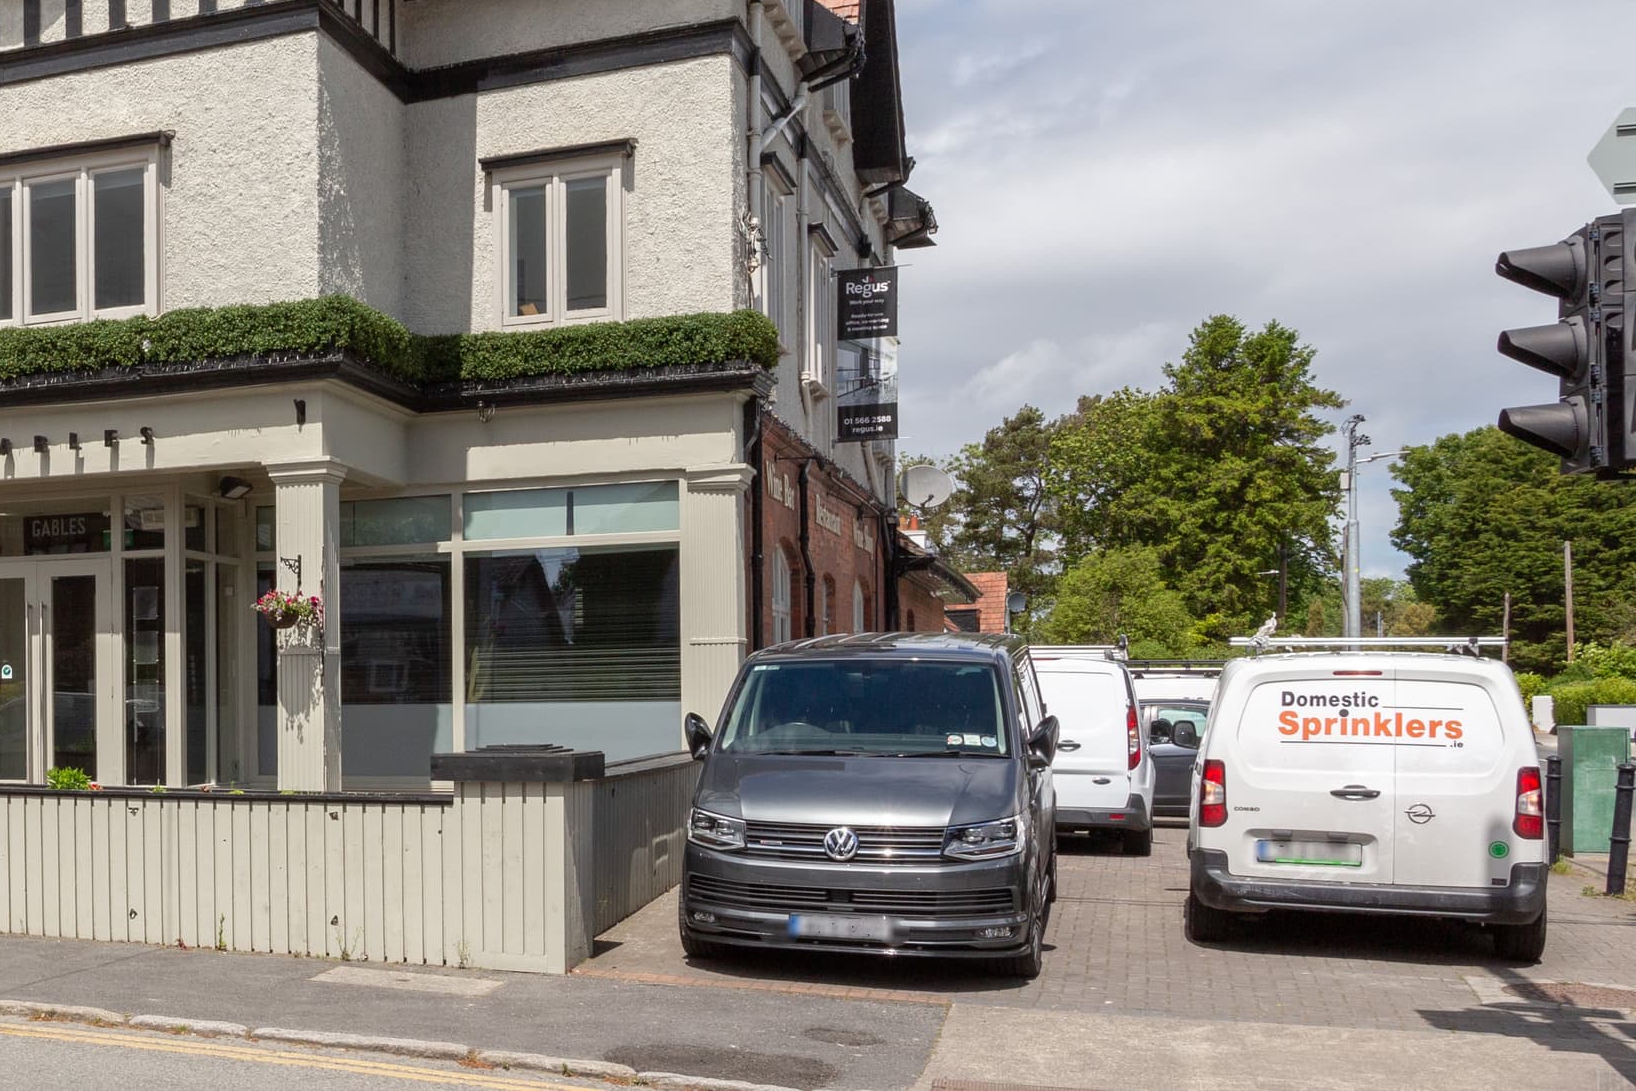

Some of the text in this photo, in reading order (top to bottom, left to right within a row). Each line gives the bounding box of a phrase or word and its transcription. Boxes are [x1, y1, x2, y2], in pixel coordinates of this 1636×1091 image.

[845, 281, 889, 298] Regus
[852, 425, 883, 434] regus.ie
[766, 461, 783, 502] Wine
[32, 517, 86, 538] GABLES
[1281, 691, 1379, 708] Domestic
[1278, 709, 1464, 740] Sprinklers
[1450, 740, 1464, 748] .ie
